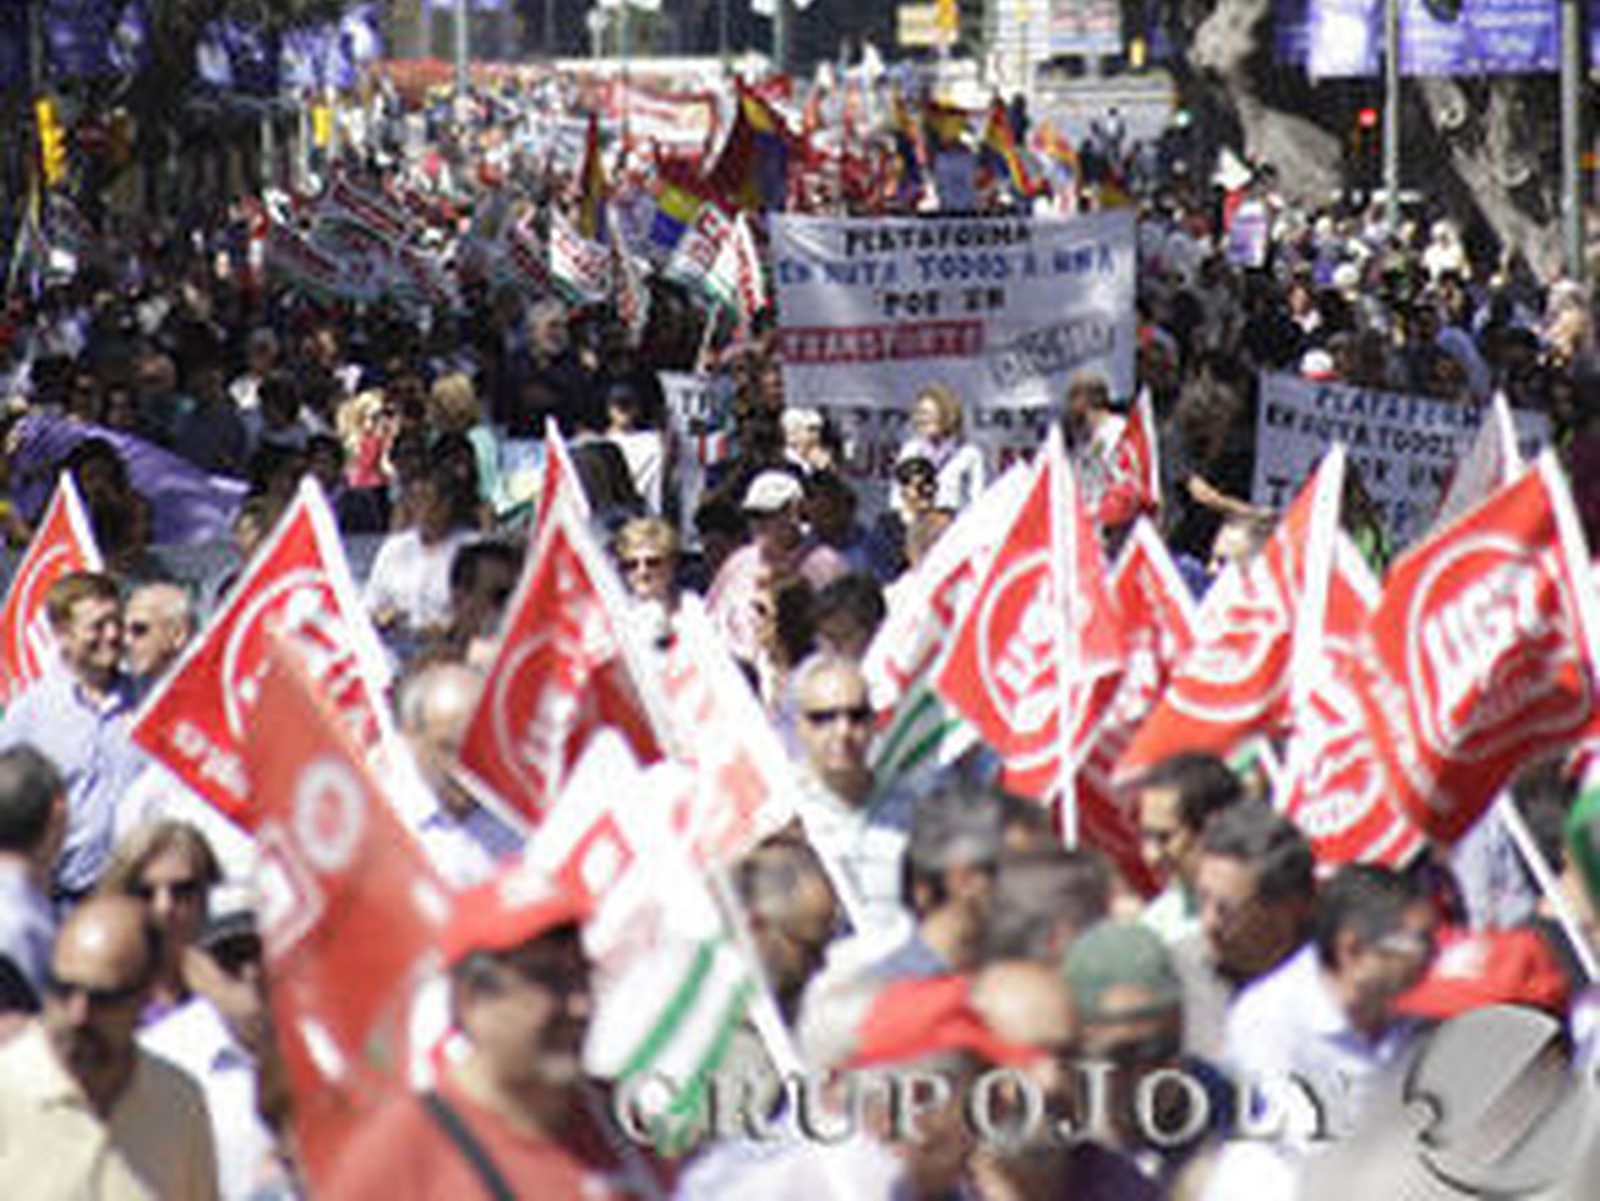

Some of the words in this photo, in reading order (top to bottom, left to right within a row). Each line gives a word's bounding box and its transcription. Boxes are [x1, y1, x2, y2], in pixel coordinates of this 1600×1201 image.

[844, 222, 1031, 256] PLATAFORMA
[916, 253, 1011, 281] TODOS
[1314, 386, 1480, 427] PLATAFORM
